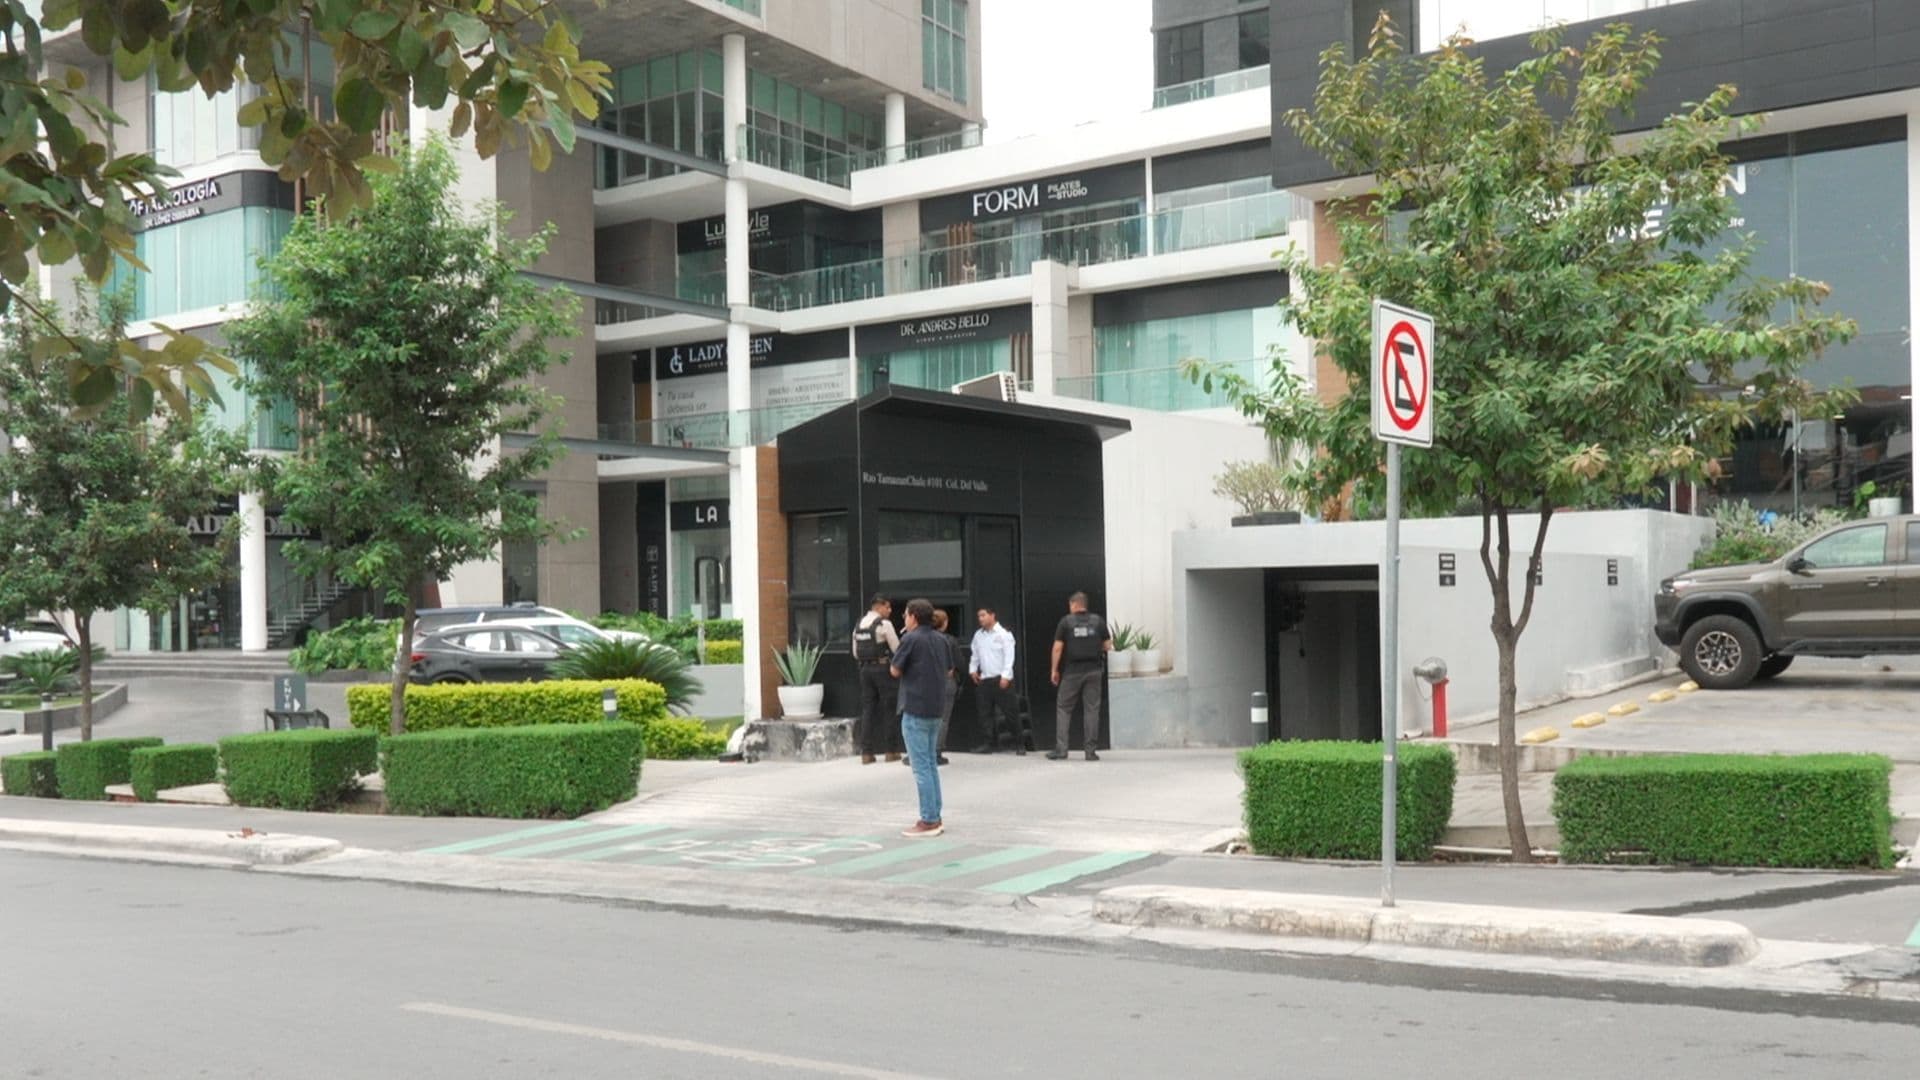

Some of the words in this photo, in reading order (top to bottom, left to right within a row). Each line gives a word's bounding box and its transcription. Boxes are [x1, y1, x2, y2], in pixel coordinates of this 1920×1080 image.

[1048, 180, 1080, 193] PILATES
[973, 184, 1038, 216] FORM
[918, 317, 957, 333] ANDRES
[959, 313, 989, 328] BELLO
[688, 343, 723, 362] LADY
